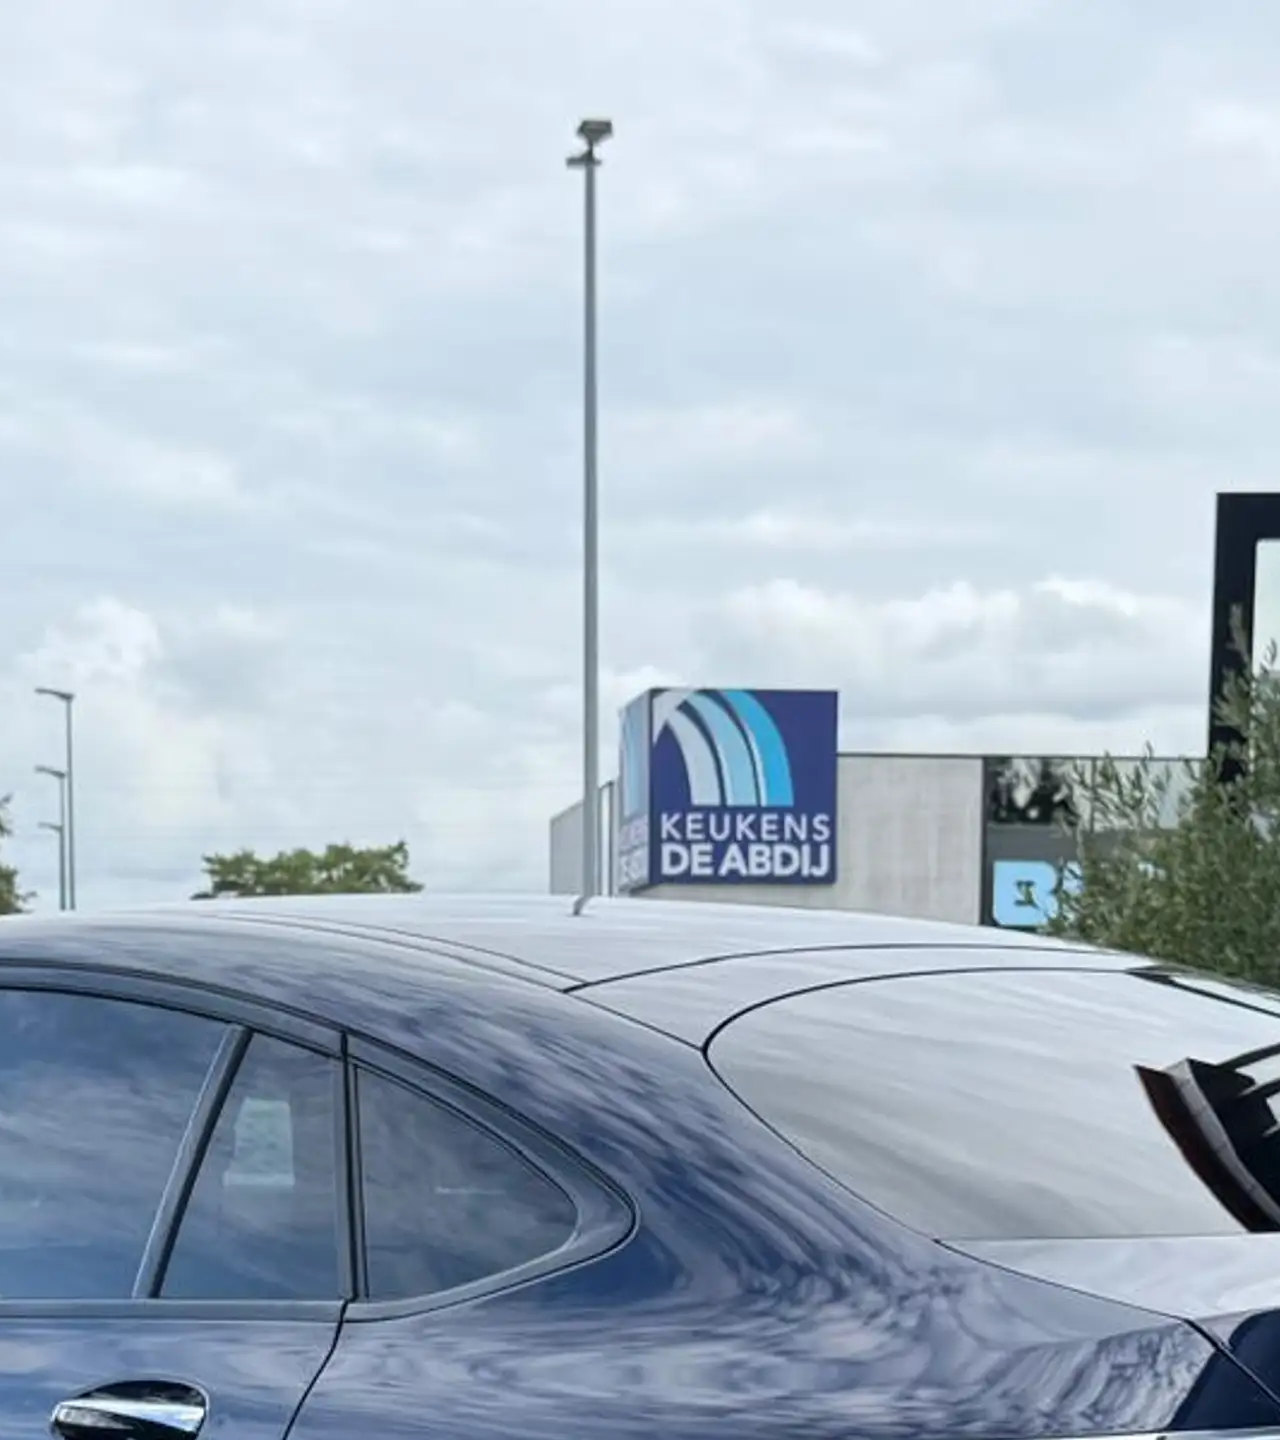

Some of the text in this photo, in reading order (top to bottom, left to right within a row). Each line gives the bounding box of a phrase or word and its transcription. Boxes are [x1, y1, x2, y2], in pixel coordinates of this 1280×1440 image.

[661, 813, 830, 842] KEUKENS
[661, 844, 714, 876] DE
[718, 844, 830, 877] ABDIJ
